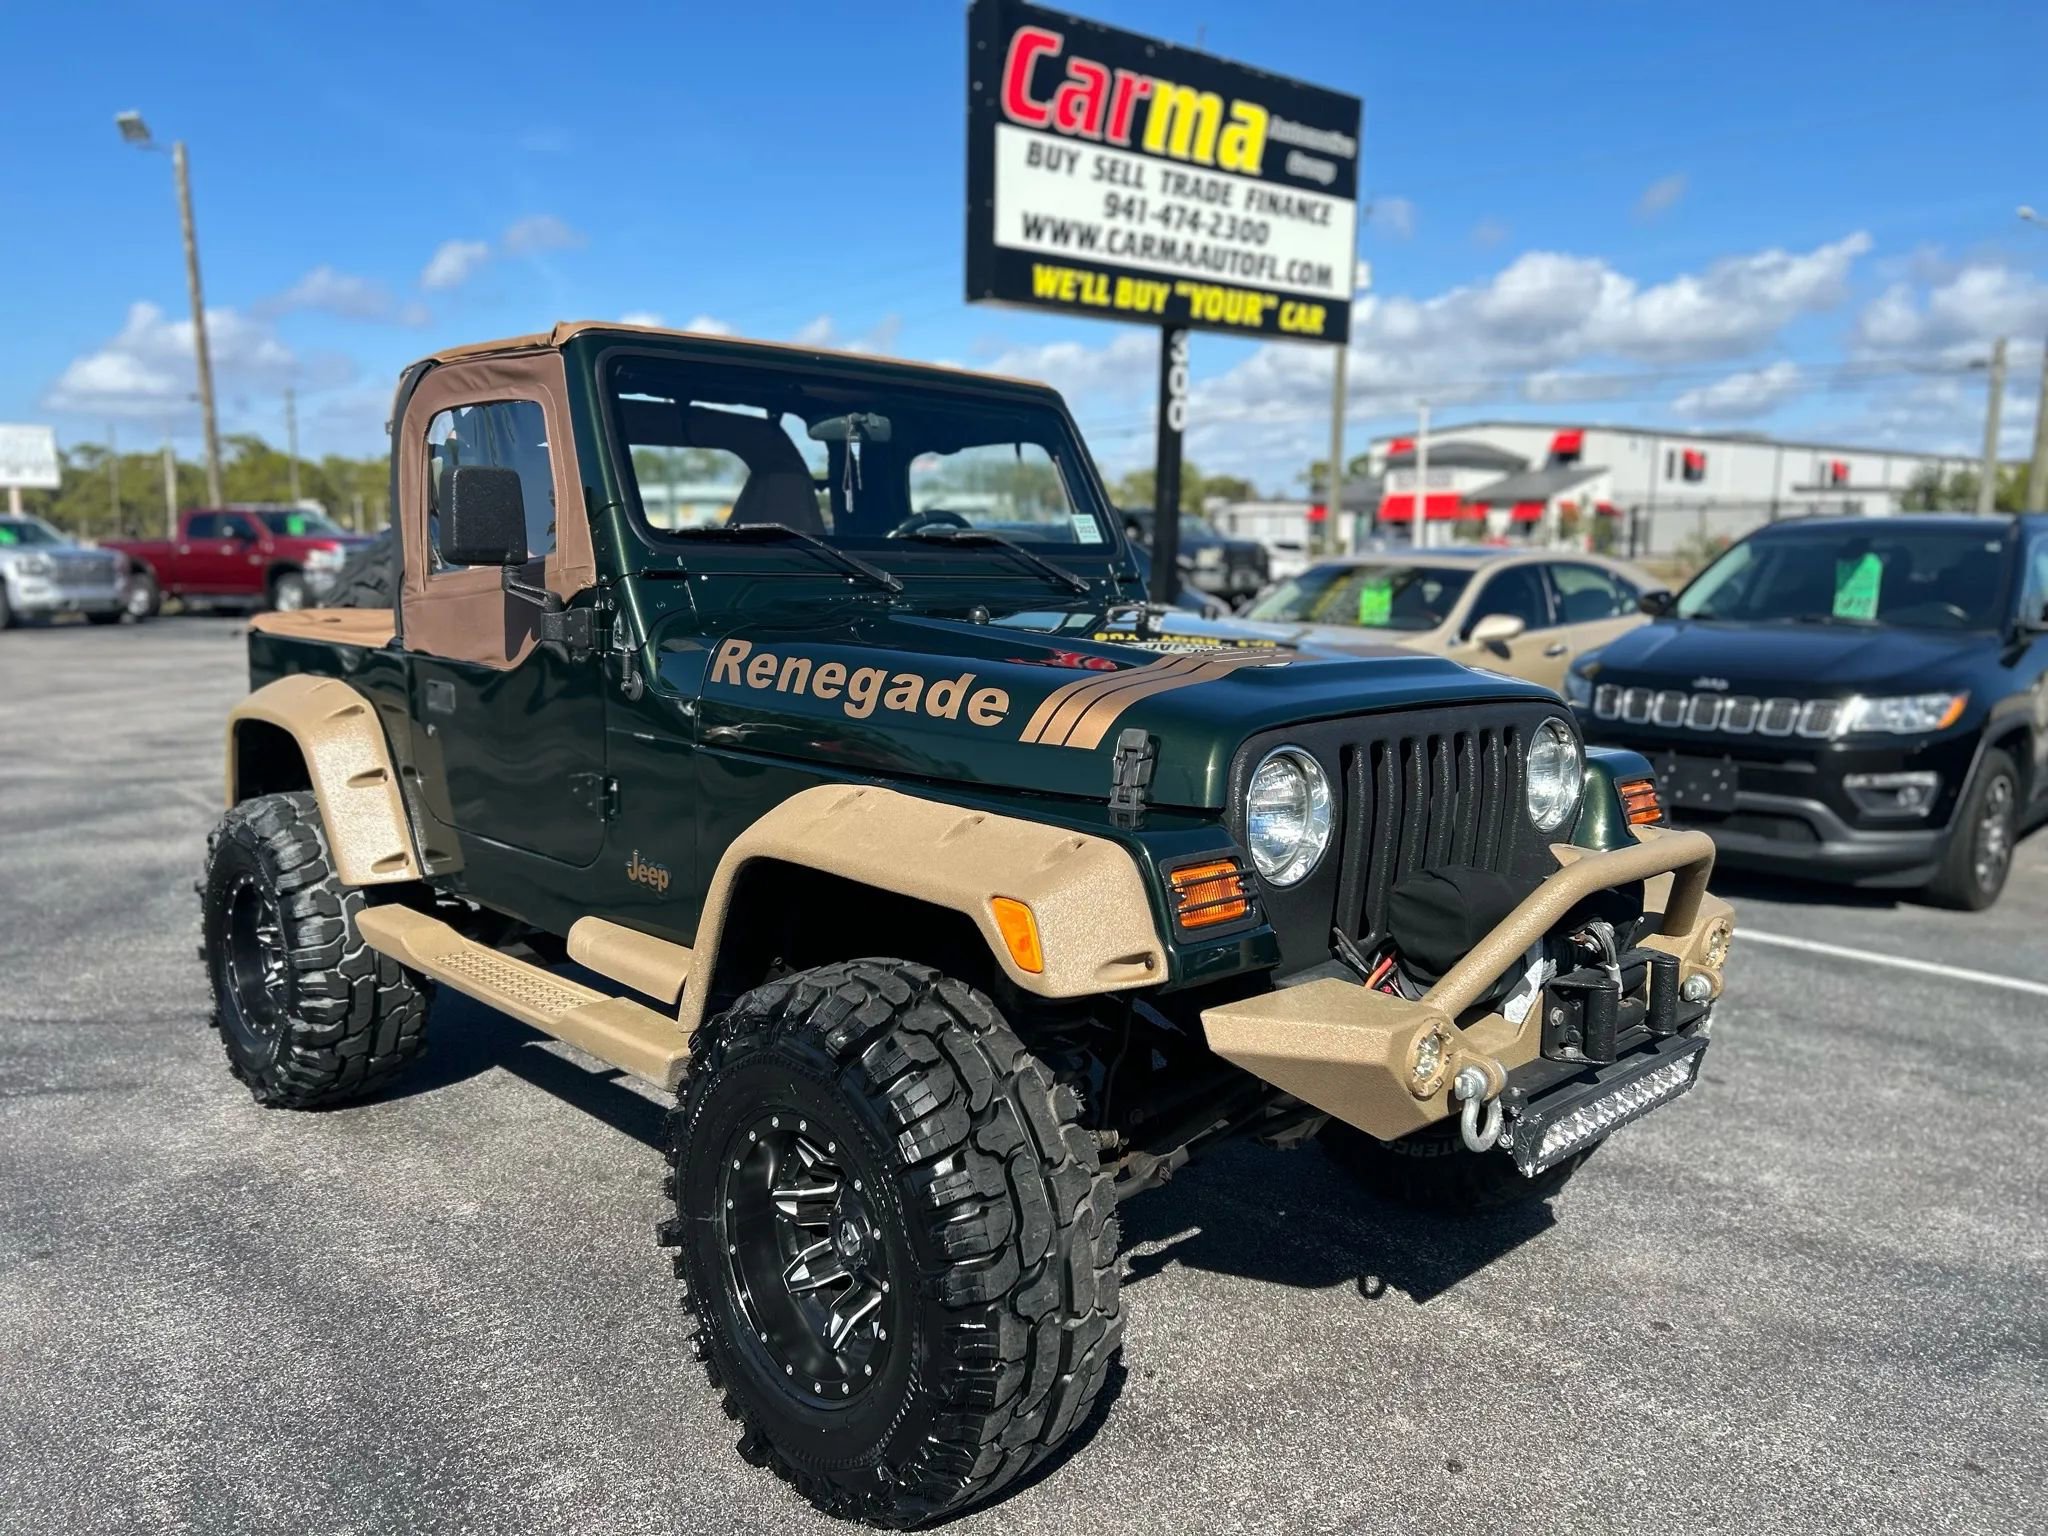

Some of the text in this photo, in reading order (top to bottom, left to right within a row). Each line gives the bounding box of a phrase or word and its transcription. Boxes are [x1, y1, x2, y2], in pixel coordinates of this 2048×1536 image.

[1001, 25, 1270, 176] Carma
[1026, 139, 1332, 227] BUY SELL TRADE FINANCE
[1103, 191, 1270, 246] 941-474-2300
[1021, 211, 1334, 288] WWW.CARMAAUTOFL.COM
[1032, 262, 1111, 306] WE'LL
[1113, 275, 1171, 314] BUY
[1277, 302, 1328, 335] CAR
[710, 638, 1011, 728] Renegade
[626, 849, 669, 893] Jeep
